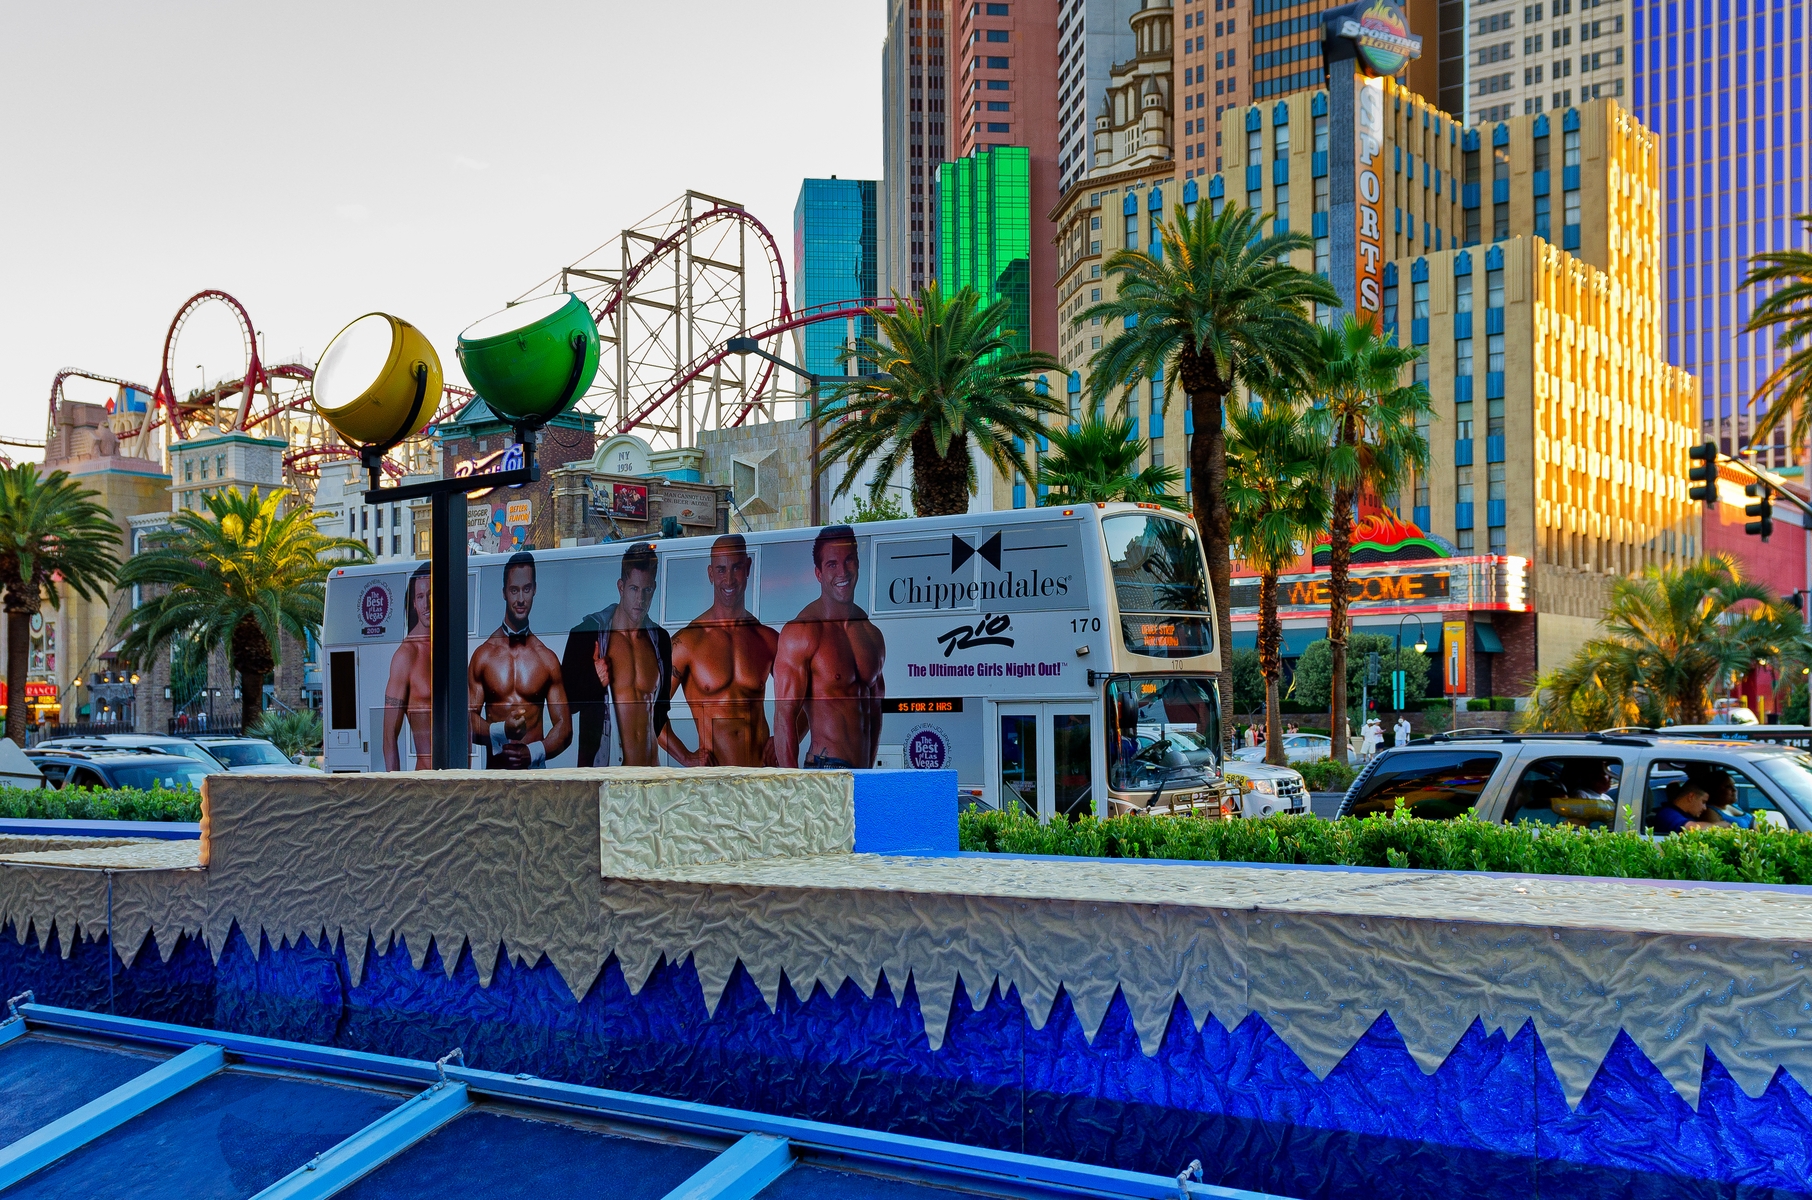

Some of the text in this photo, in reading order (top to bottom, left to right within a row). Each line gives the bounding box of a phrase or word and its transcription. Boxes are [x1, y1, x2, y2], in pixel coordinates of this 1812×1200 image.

[1341, 20, 1421, 50] SPORTING
[1360, 36, 1410, 57] HOUSE
[1360, 85, 1381, 313] SPORTS
[618, 451, 631, 461] NY
[617, 463, 633, 472] 1936
[889, 569, 1068, 609] Chippendales
[1287, 573, 1426, 605] WECOME
[366, 596, 384, 607] Best
[365, 611, 384, 622] Vegas
[1071, 617, 1101, 633] 170
[937, 613, 1015, 657] Rio
[907, 663, 927, 677] The
[929, 663, 975, 677] Ultimate
[977, 662, 1003, 677] Girls
[1005, 662, 1036, 678] Night
[1038, 662, 1061, 676] Out!
[1171, 660, 1184, 670] 170
[26, 687, 54, 695] RANCE
[898, 702, 952, 711] $5 FOR 2 HRS
[921, 736, 932, 744] The
[1784, 739, 1810, 747] THE
[915, 741, 939, 753] Best
[924, 752, 937, 760] Las
[915, 757, 939, 769] Vegas
